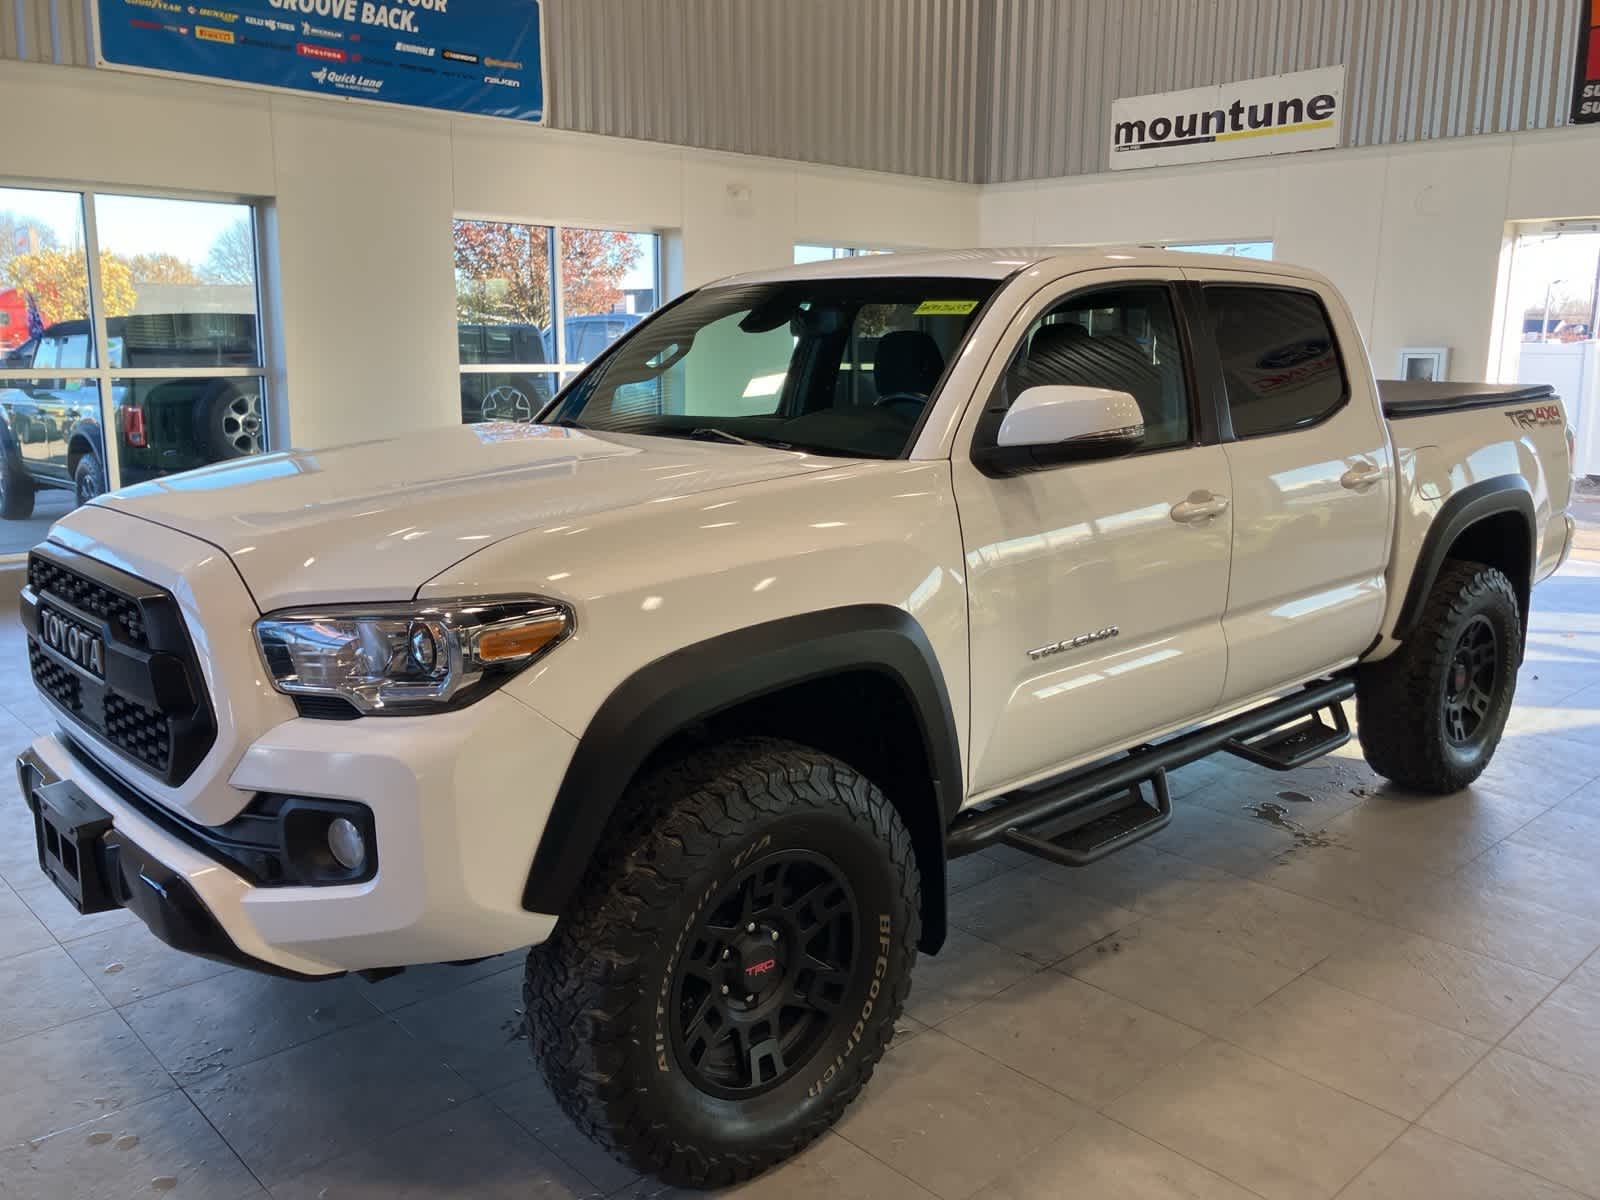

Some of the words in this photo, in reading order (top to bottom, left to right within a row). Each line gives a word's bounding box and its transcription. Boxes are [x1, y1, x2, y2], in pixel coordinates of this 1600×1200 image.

[360, 3, 419, 33] BACK.
[327, 71, 357, 84] Quick
[1114, 93, 1337, 146] mountune
[41, 608, 105, 675] TOYOTA
[745, 959, 776, 977] TRD
